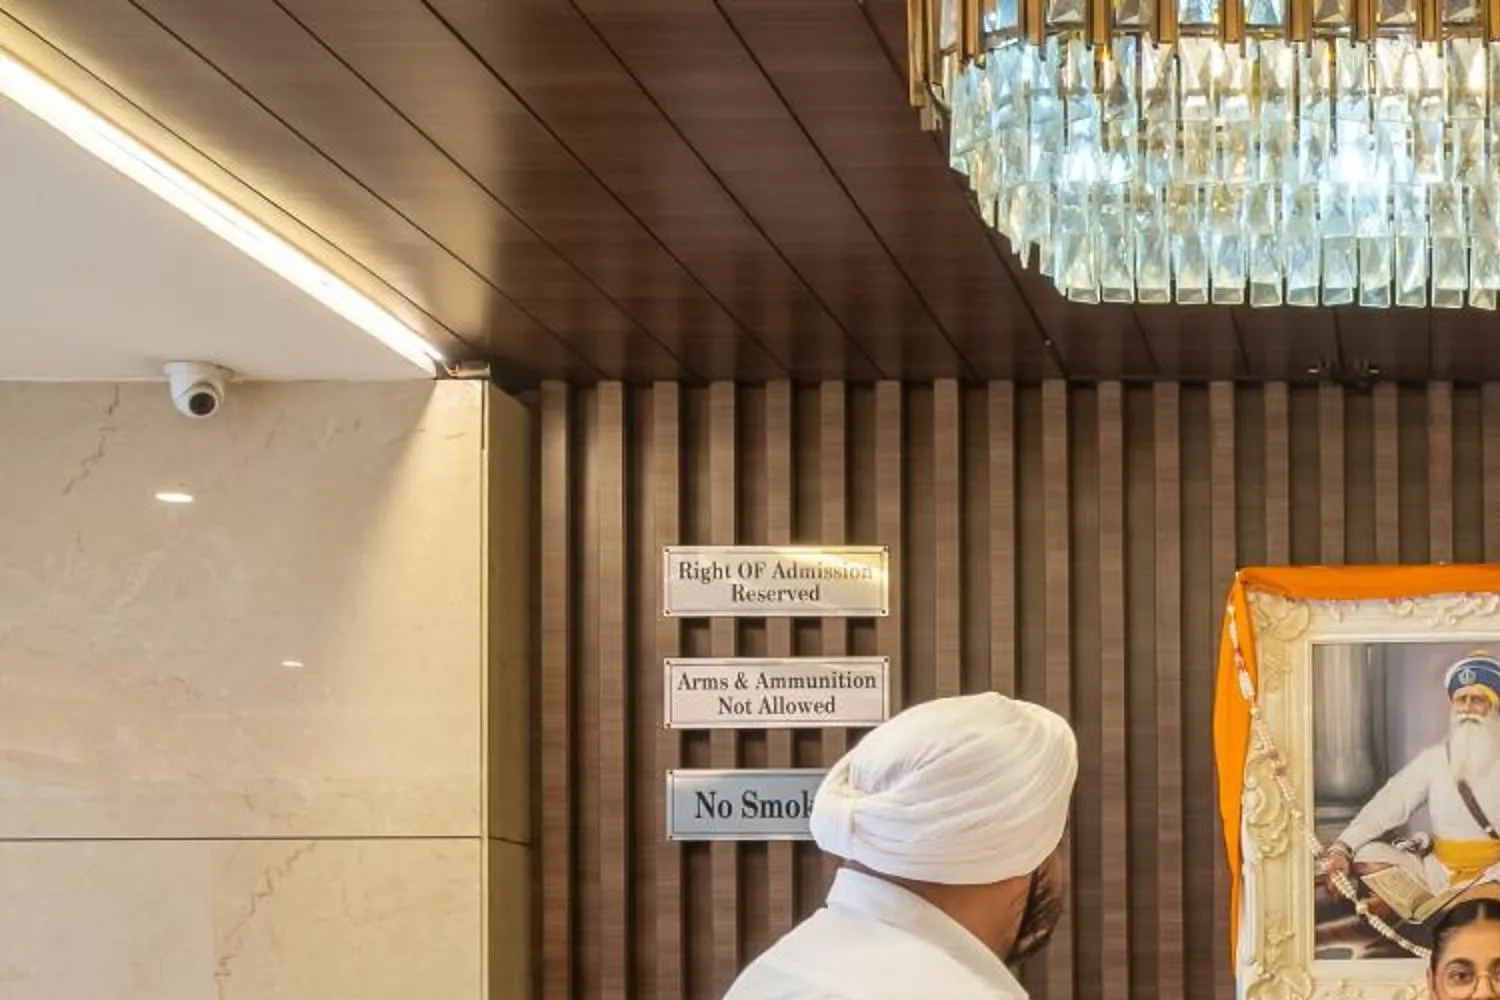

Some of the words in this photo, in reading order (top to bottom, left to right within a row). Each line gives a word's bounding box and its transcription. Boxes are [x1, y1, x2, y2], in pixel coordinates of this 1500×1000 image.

[678, 561, 732, 584] Right
[737, 562, 767, 579] OF
[772, 561, 873, 579] Admission
[732, 584, 821, 602] Reserved
[677, 672, 729, 690] Arms
[734, 672, 749, 690] &
[755, 672, 877, 689] Ammunition
[718, 696, 753, 714] Not
[758, 696, 836, 714] Allowed
[695, 791, 733, 819] No
[741, 790, 814, 819] Smok
